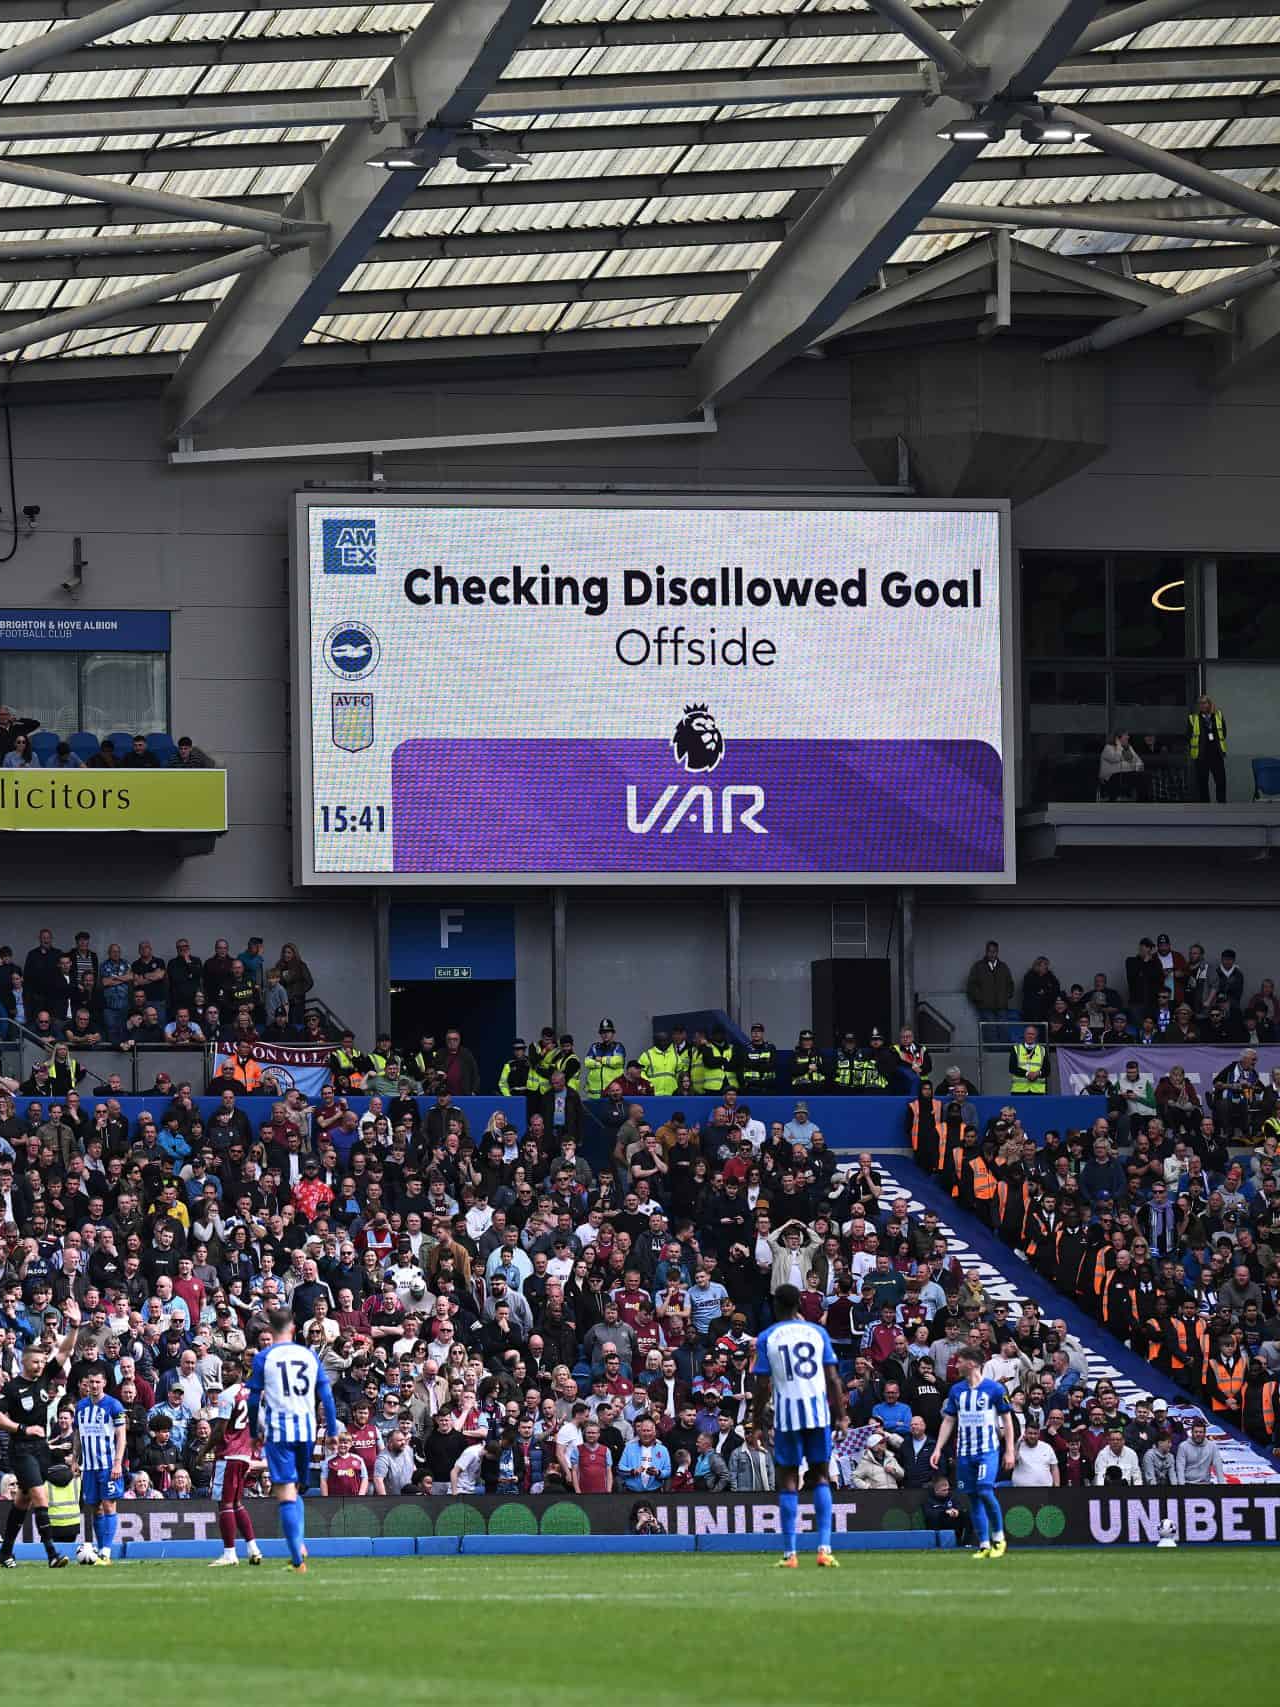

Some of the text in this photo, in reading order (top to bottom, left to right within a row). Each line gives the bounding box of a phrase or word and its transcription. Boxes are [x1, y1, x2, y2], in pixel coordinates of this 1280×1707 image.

[404, 564, 982, 616] Checking Disallowed Goal
[0, 620, 118, 630] BRIGHTON & HOVE ALBION
[0, 629, 72, 638] FOOTBALL CLUB
[615, 627, 777, 667] Offside
[336, 695, 371, 707] AVFC
[320, 804, 385, 833] 15:41
[626, 784, 769, 834] VAR
[439, 908, 465, 949] F
[437, 969, 451, 977] Exit
[778, 1341, 818, 1381] 18
[276, 1360, 310, 1397] 13
[107, 1480, 117, 1495] 5
[977, 1463, 988, 1481] 11
[1088, 1497, 1280, 1543] UNIBET
